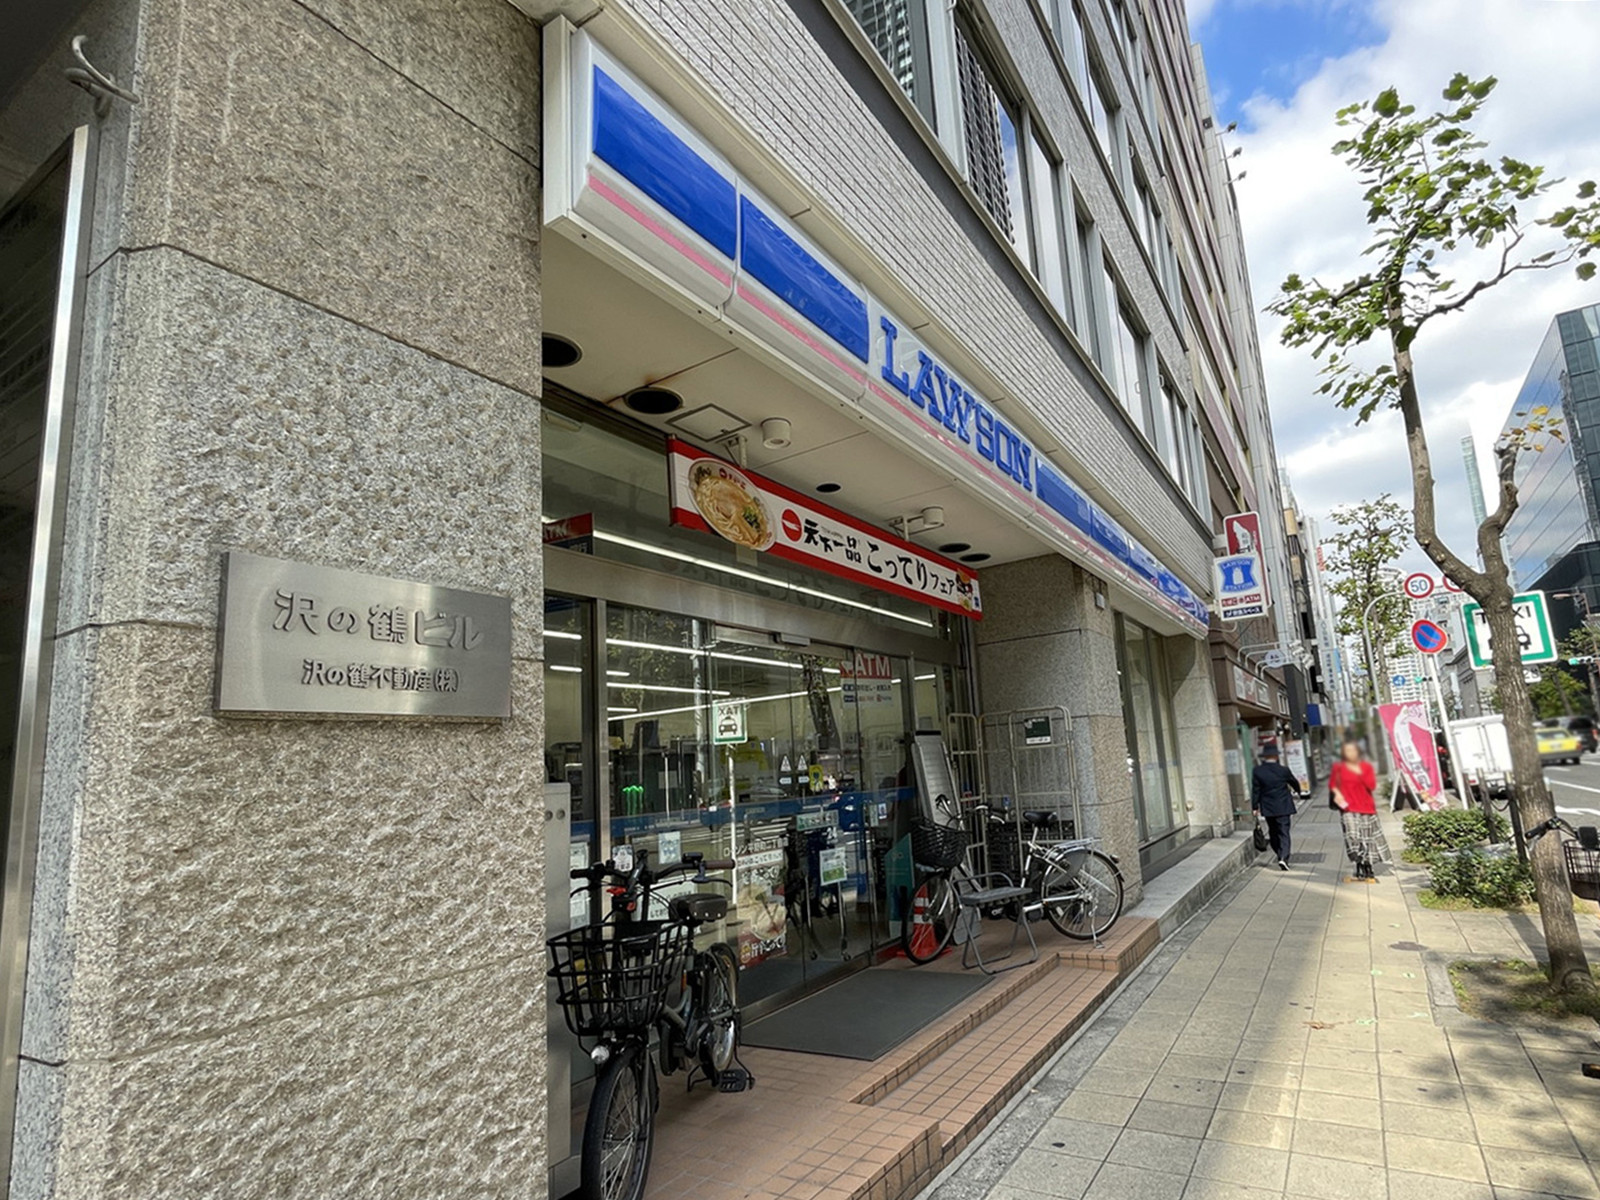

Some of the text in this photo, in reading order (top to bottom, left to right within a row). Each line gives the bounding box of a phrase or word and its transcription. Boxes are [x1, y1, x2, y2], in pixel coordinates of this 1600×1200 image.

[881, 316, 1032, 492] LAWSON
[804, 518, 862, 564] 天下一品
[1222, 559, 1251, 570] LAWSON
[1225, 581, 1254, 591] STATION
[1410, 579, 1428, 593] 50
[1245, 594, 1260, 603] ATM
[273, 588, 484, 651] 沢の鶴ビル
[1475, 605, 1531, 624] TXI
[302, 658, 459, 693] 沢の鶴不動産(株)
[855, 653, 890, 677] ATM
